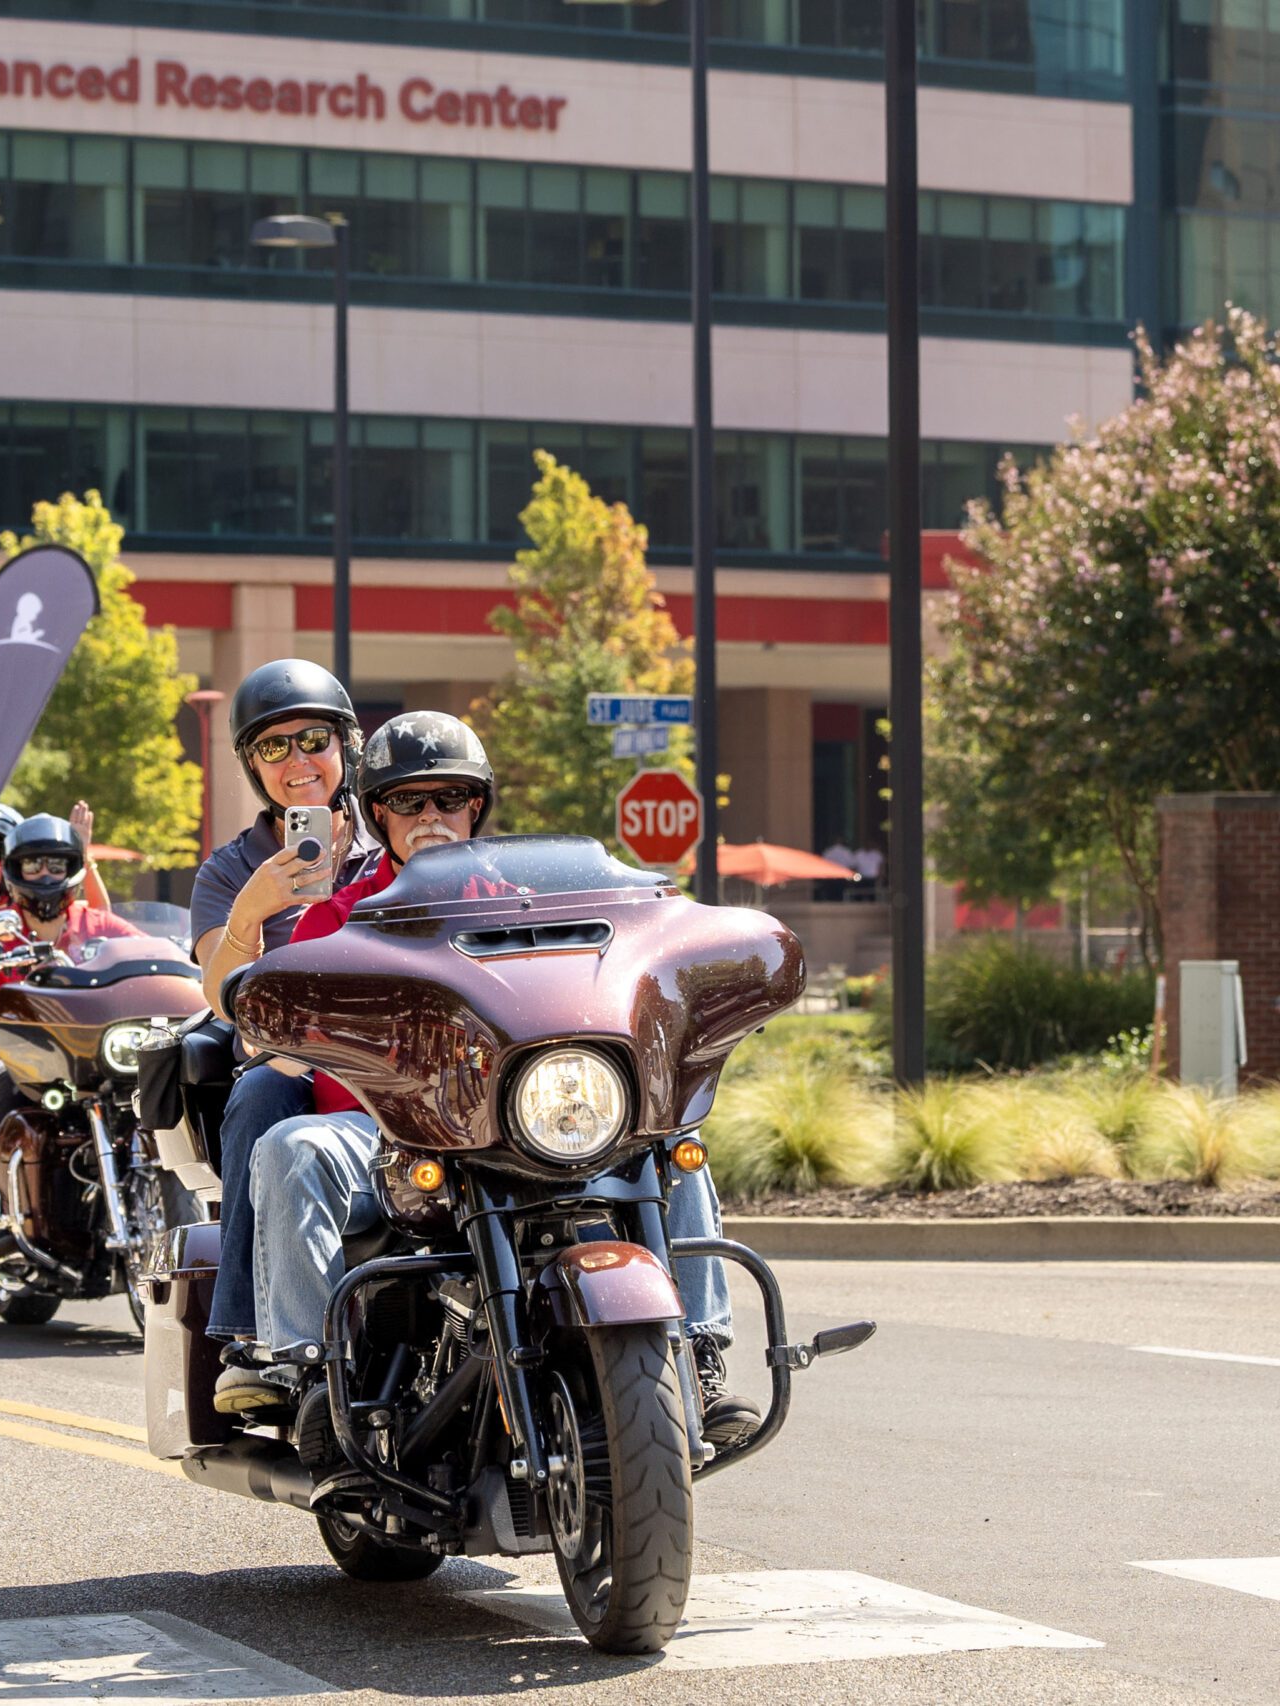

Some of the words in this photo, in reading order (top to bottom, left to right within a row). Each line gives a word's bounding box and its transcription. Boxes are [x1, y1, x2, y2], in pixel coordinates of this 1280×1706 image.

[155, 60, 386, 122] Research
[399, 77, 567, 132] Center
[623, 800, 697, 837] STOP
